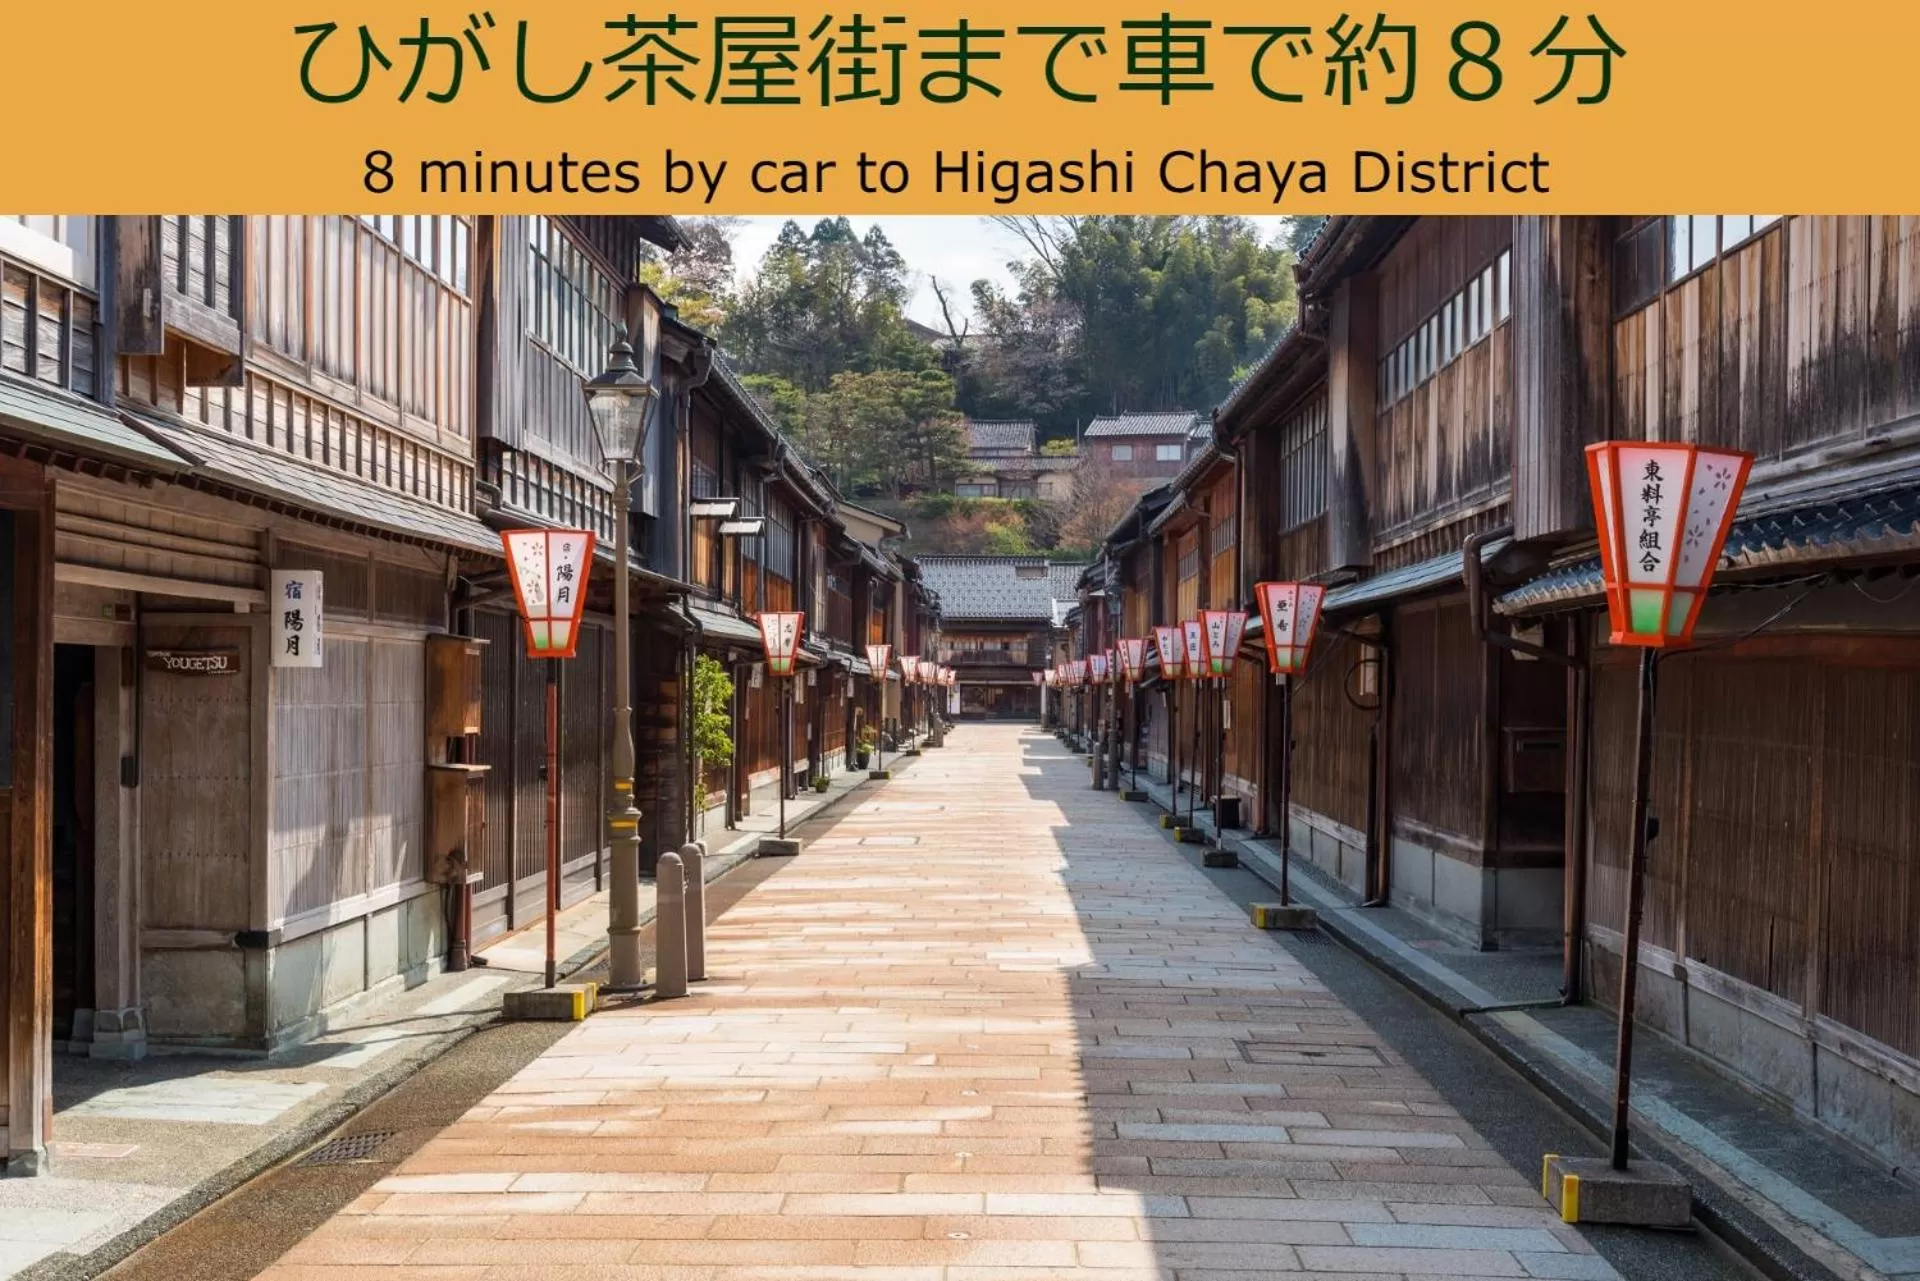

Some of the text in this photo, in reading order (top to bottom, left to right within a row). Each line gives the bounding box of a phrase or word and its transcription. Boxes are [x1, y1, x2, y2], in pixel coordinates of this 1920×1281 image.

[1638, 458, 1665, 573] 東料亭組合
[163, 655, 228, 671] YOUGETSU
